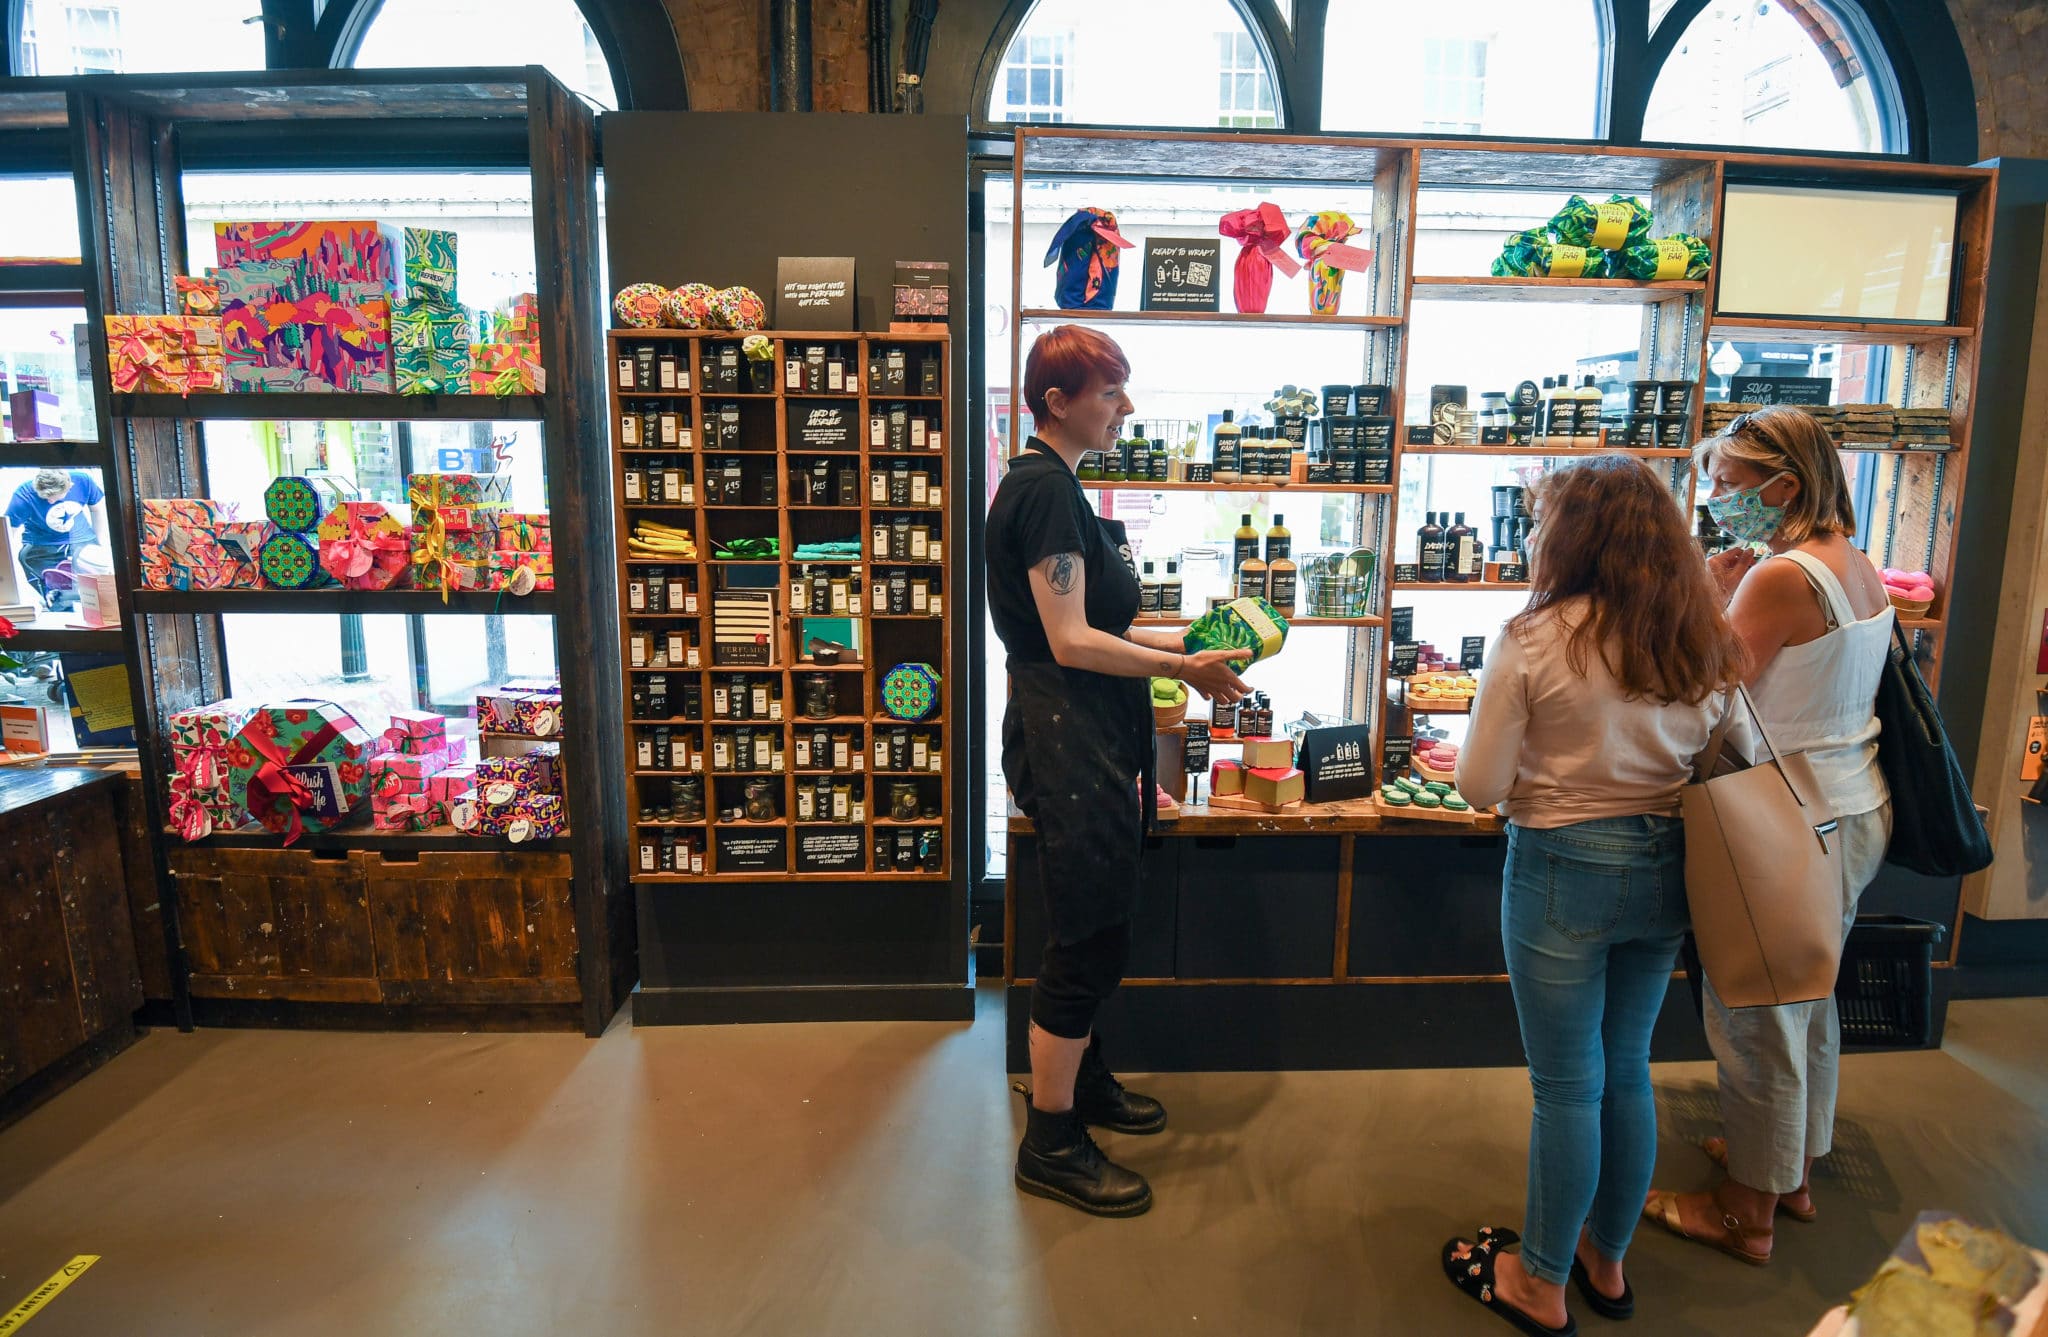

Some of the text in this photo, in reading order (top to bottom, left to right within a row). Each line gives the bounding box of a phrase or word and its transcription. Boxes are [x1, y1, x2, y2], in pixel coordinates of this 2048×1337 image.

[1606, 215, 1623, 225] BAG
[1151, 247, 1216, 257] READY TO WRAP?
[1561, 252, 1579, 260] BAG
[1667, 253, 1683, 261] BAG
[420, 270, 445, 283] REFRESH
[808, 282, 828, 290] RIGHT
[827, 281, 846, 289] NOTE
[809, 289, 846, 298] PERFUME
[798, 298, 813, 307] GIFT
[1742, 382, 1773, 393] SOLID
[437, 447, 491, 474] BT
[724, 480, 740, 492] £95
